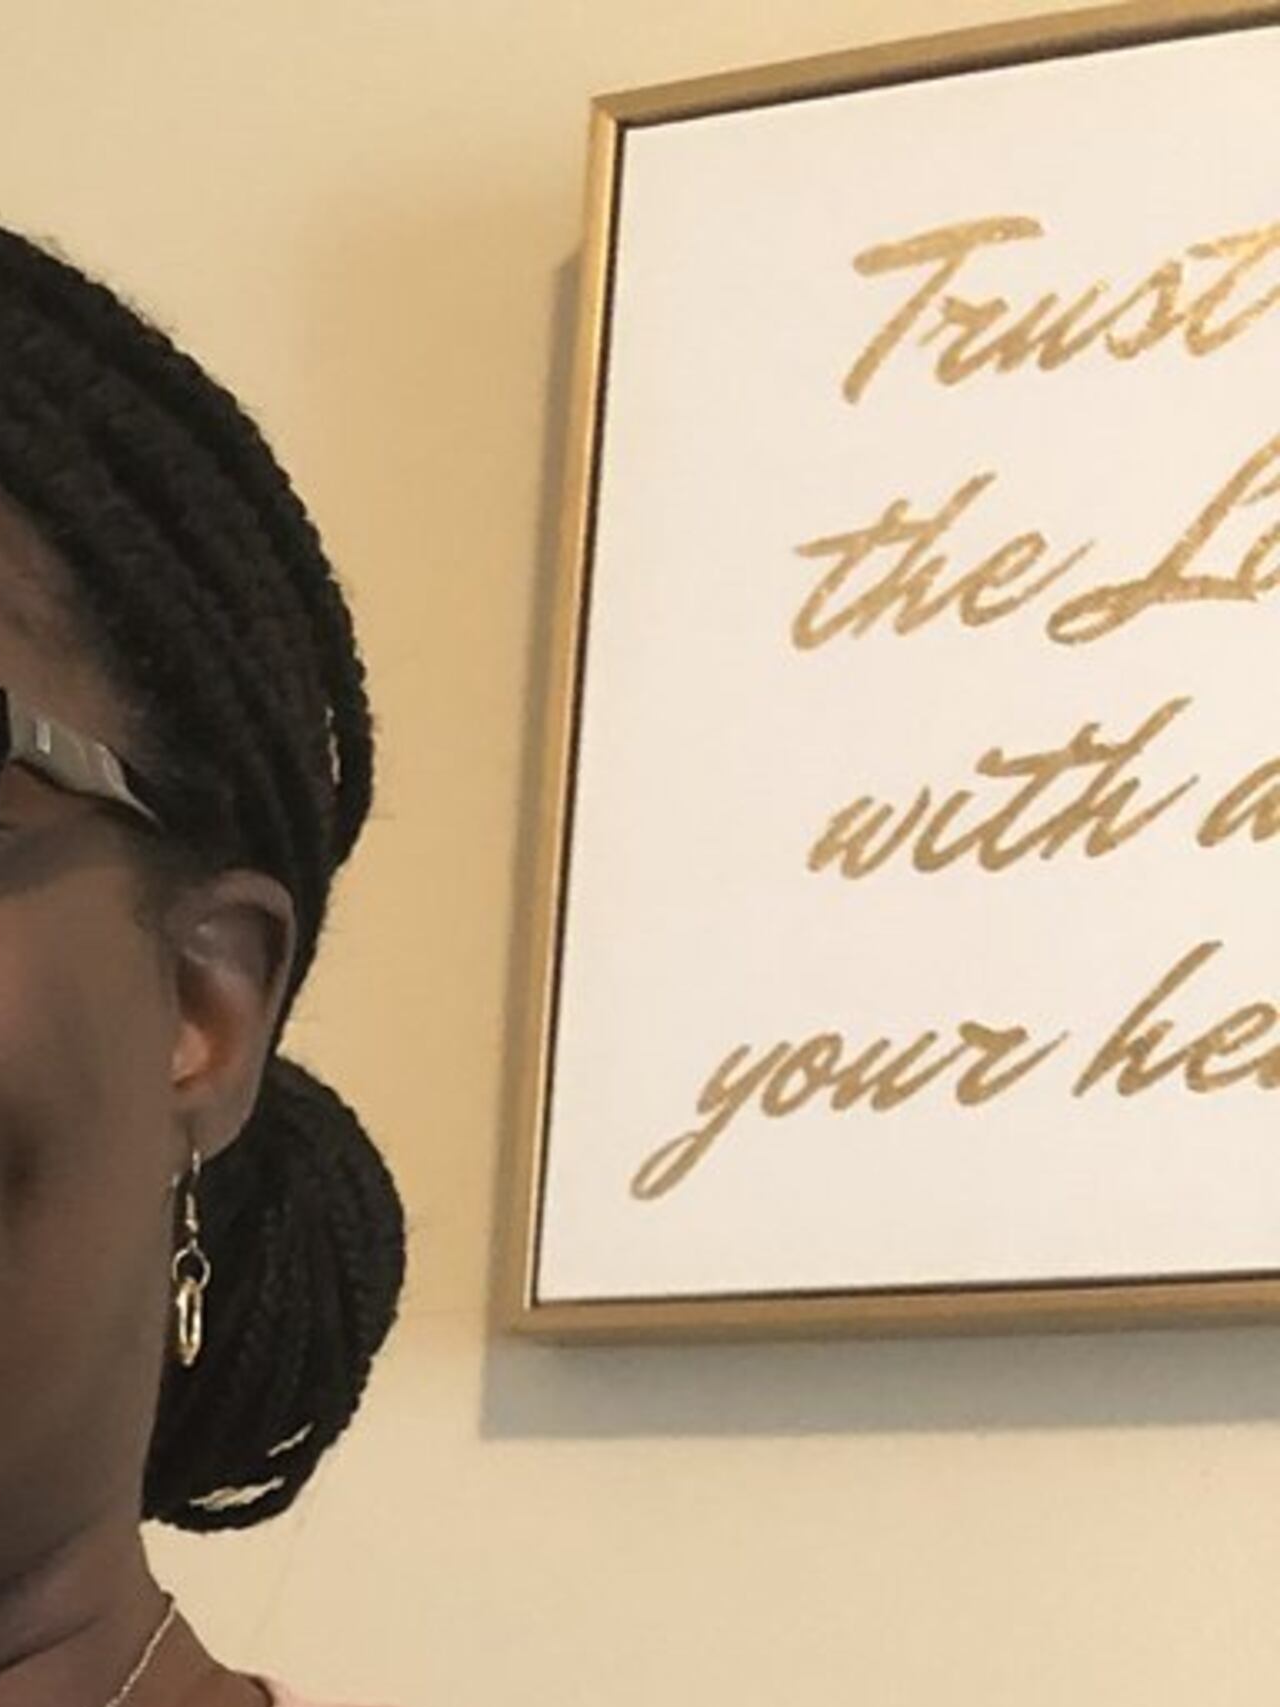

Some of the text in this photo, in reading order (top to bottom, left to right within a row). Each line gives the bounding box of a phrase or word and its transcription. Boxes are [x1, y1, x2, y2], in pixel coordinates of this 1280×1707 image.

[841, 213, 1280, 405] Trust
[792, 470, 1093, 652] the
[807, 695, 1200, 880] with
[630, 1012, 1070, 1202] your
